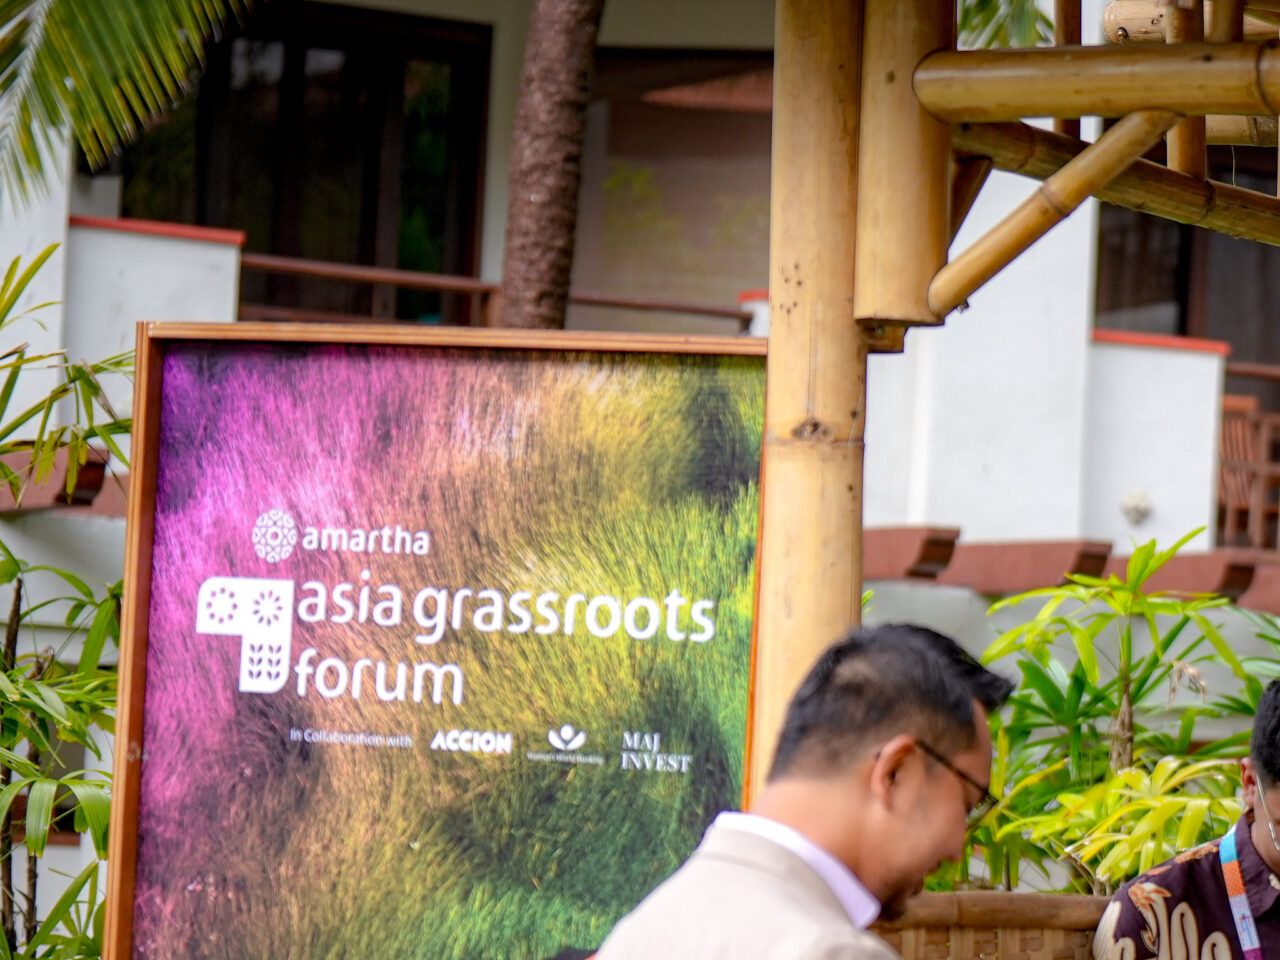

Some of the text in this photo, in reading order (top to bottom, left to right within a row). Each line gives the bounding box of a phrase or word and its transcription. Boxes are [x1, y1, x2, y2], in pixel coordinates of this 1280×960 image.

[302, 525, 430, 555] amartha
[297, 569, 717, 645] asia grassroots
[294, 647, 465, 706] forum
[303, 728, 384, 746] Collaboration
[386, 733, 412, 748] with
[430, 730, 512, 753] ACCION
[622, 731, 661, 753] MAJ
[620, 752, 693, 773] INVEST
